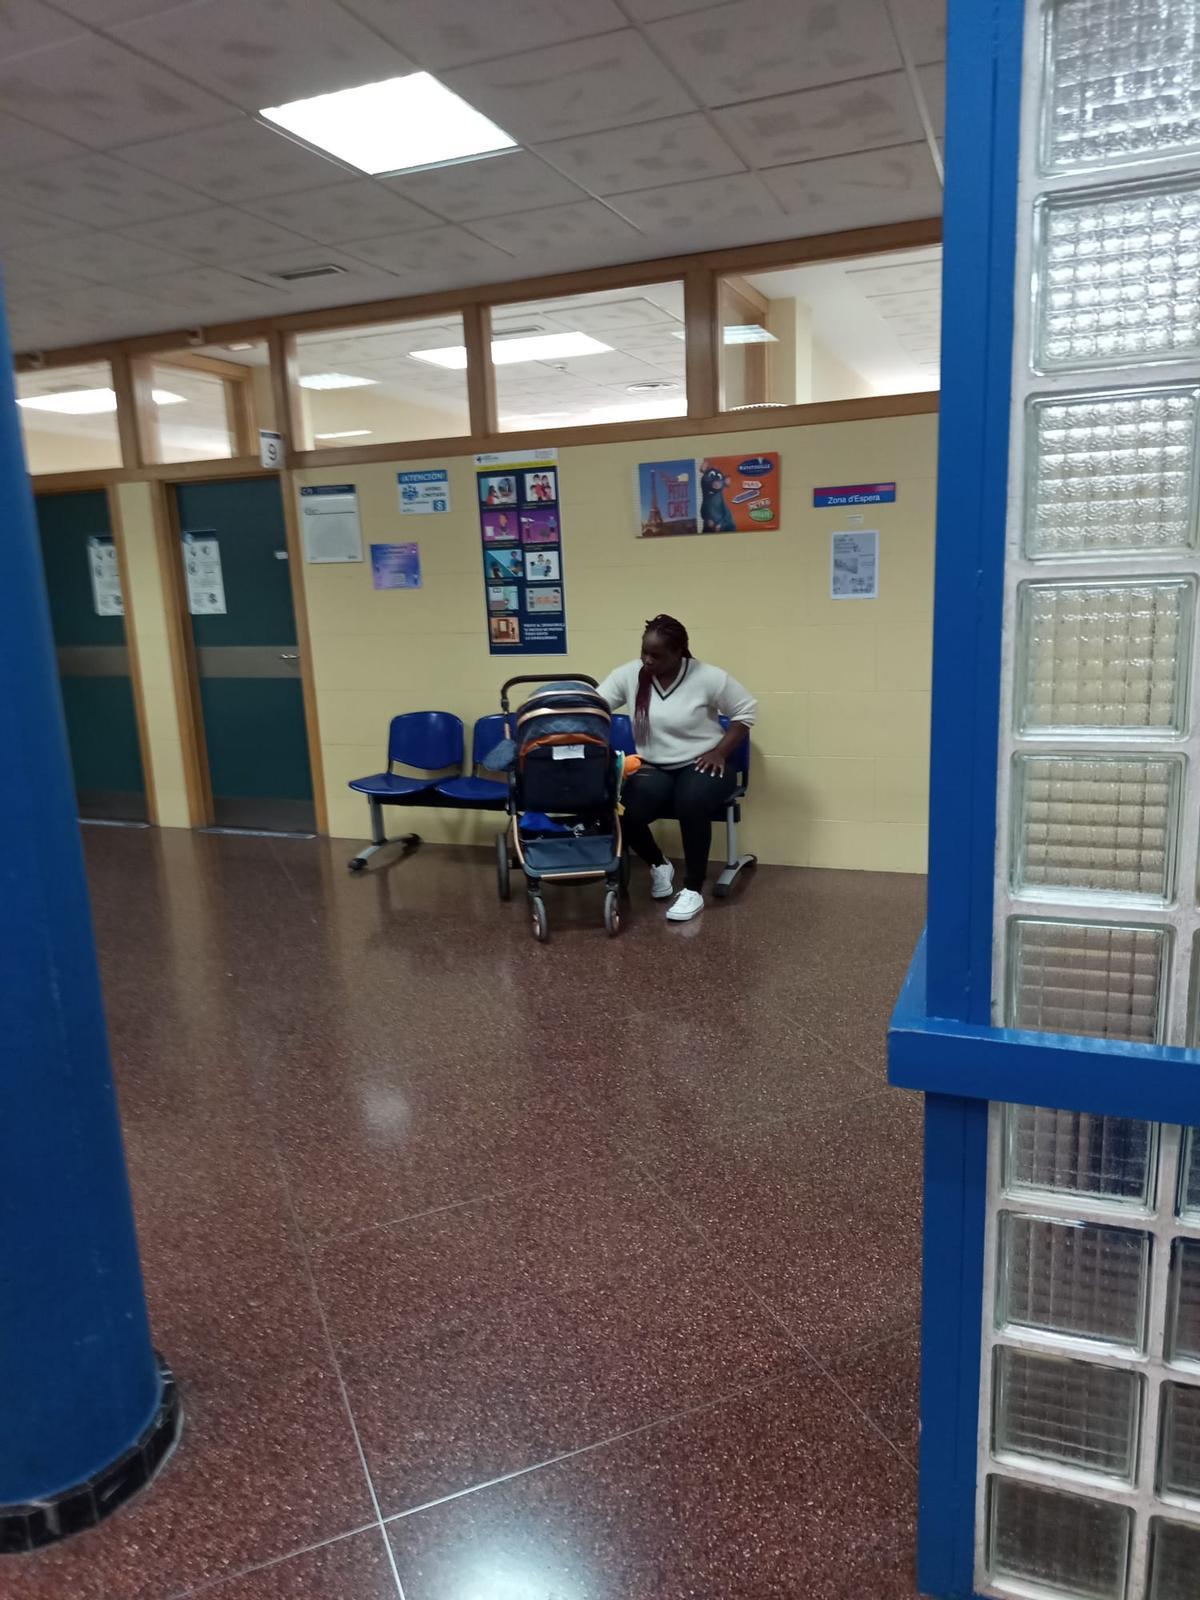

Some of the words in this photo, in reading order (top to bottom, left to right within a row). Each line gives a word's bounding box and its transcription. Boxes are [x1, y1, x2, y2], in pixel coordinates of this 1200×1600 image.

[268, 443, 277, 461] 9
[827, 496, 847, 504] Zona
[847, 494, 880, 504] d'Espera
